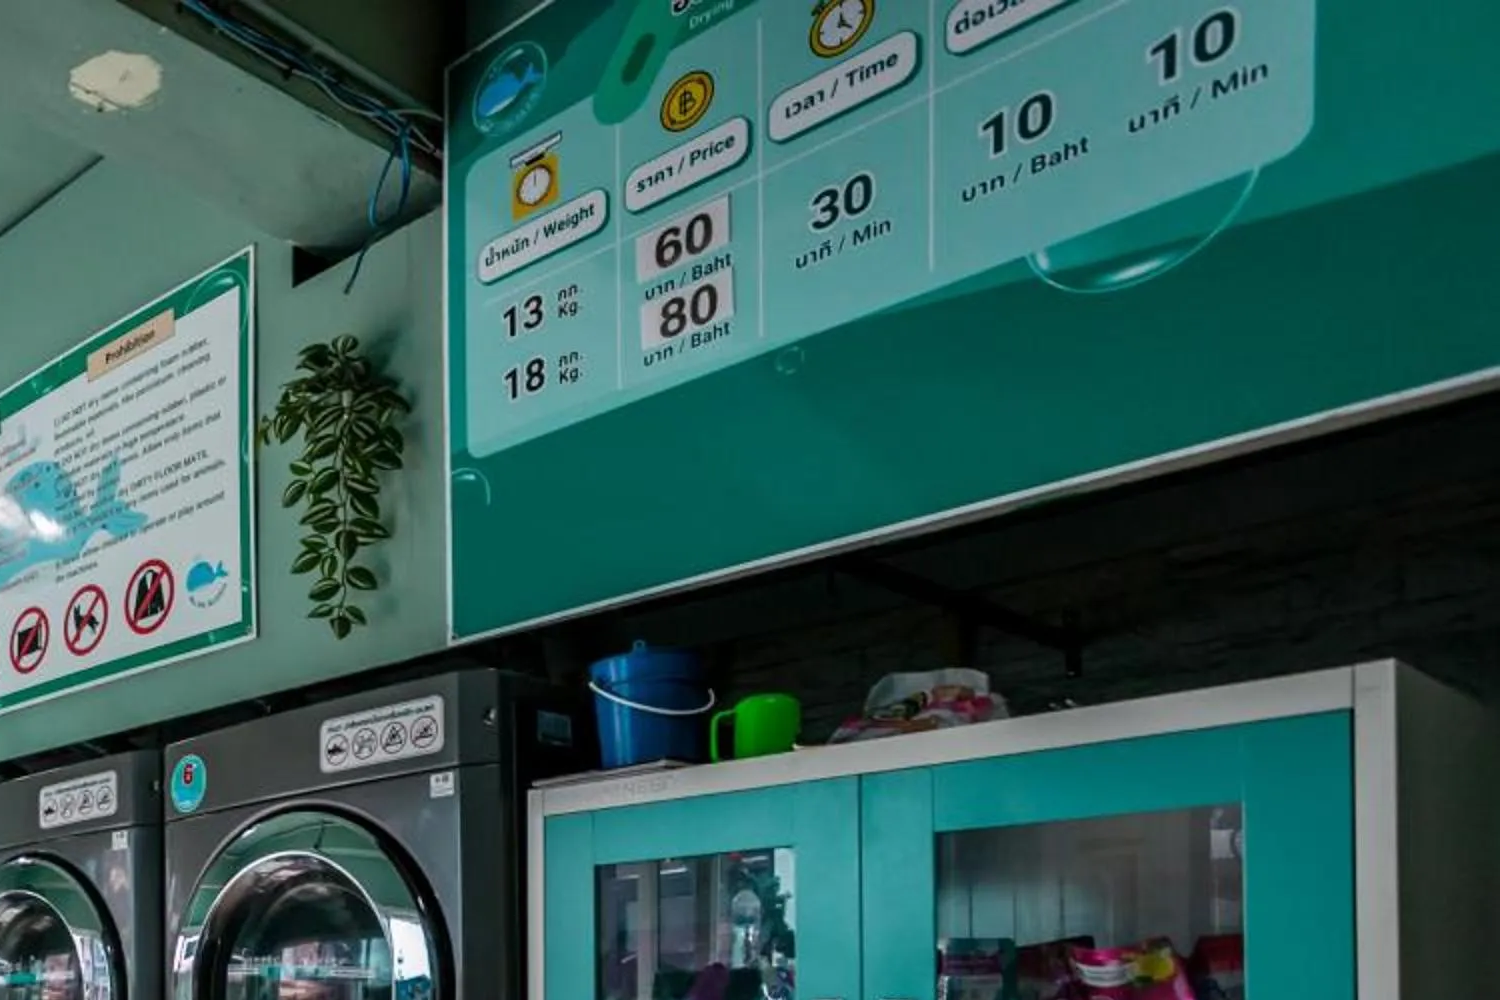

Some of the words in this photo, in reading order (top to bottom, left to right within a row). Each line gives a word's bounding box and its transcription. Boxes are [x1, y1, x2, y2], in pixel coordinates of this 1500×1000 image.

[1150, 9, 1236, 81] 10
[785, 90, 825, 119] เวลา
[845, 53, 899, 87] Time
[1212, 63, 1269, 98] Min
[982, 93, 1053, 155] 10
[636, 166, 674, 193] ราคา
[689, 134, 735, 168] Price
[962, 173, 1005, 203] บาท
[1030, 136, 1089, 175] Baht
[543, 203, 595, 238] Weight
[811, 174, 873, 230] 30
[655, 212, 713, 269] 60
[853, 219, 891, 247] Min
[645, 278, 675, 301] บาท
[692, 253, 732, 281] Baht
[503, 295, 543, 337] 13
[659, 283, 718, 339] 80
[643, 344, 674, 368] บาท
[691, 322, 731, 349] Baht
[504, 357, 546, 400] 18
